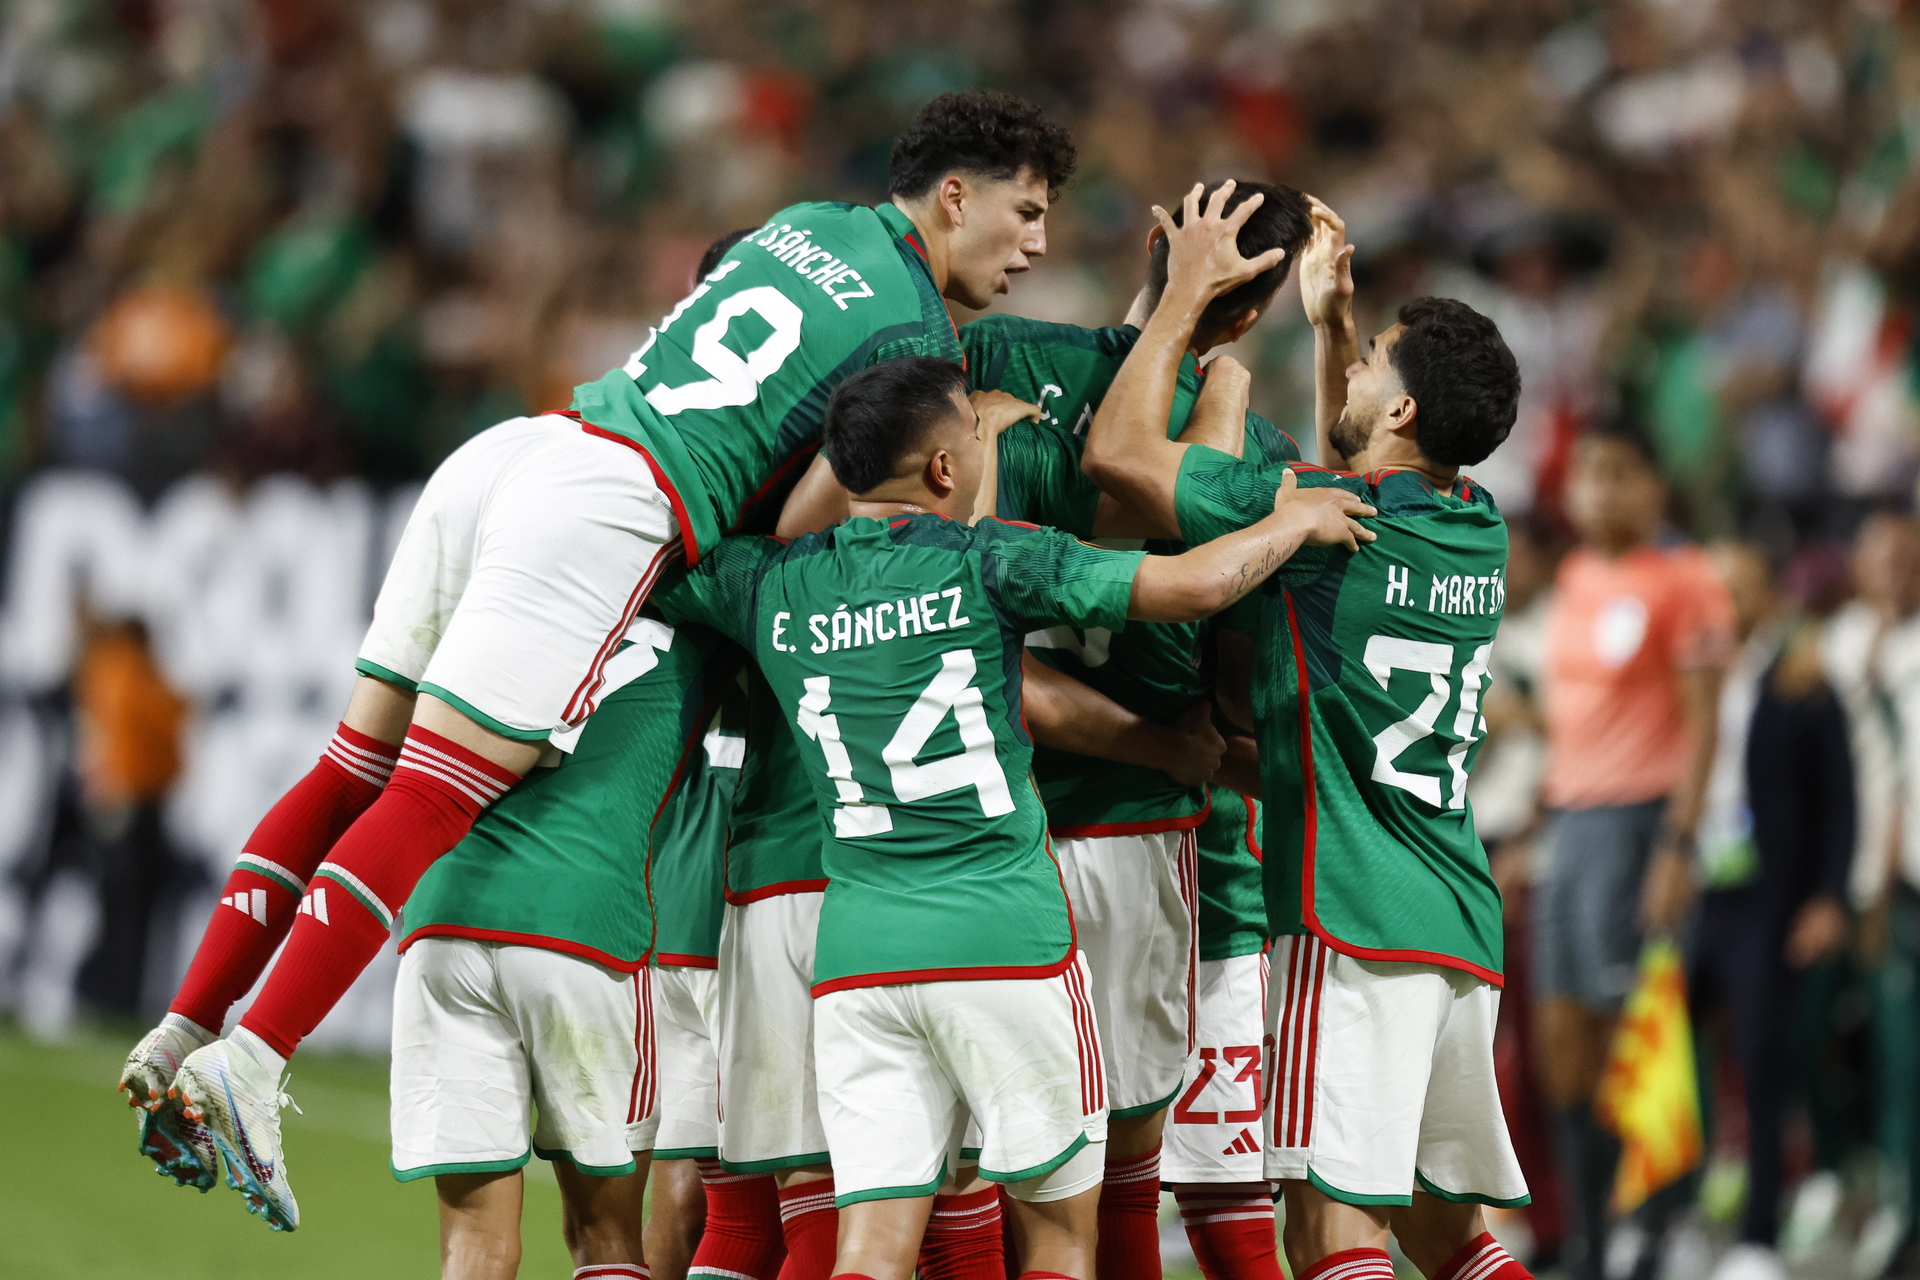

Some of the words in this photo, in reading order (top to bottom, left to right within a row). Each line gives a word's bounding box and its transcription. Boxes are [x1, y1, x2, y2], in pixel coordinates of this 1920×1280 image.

[757, 223, 875, 311] SÁNCHEZ
[623, 259, 803, 416] 19
[772, 611, 797, 653] E.
[808, 586, 970, 655] SÁNCHEZ
[1385, 565, 1415, 607] H.
[796, 648, 1016, 838] 14
[1174, 1045, 1262, 1125] 23
